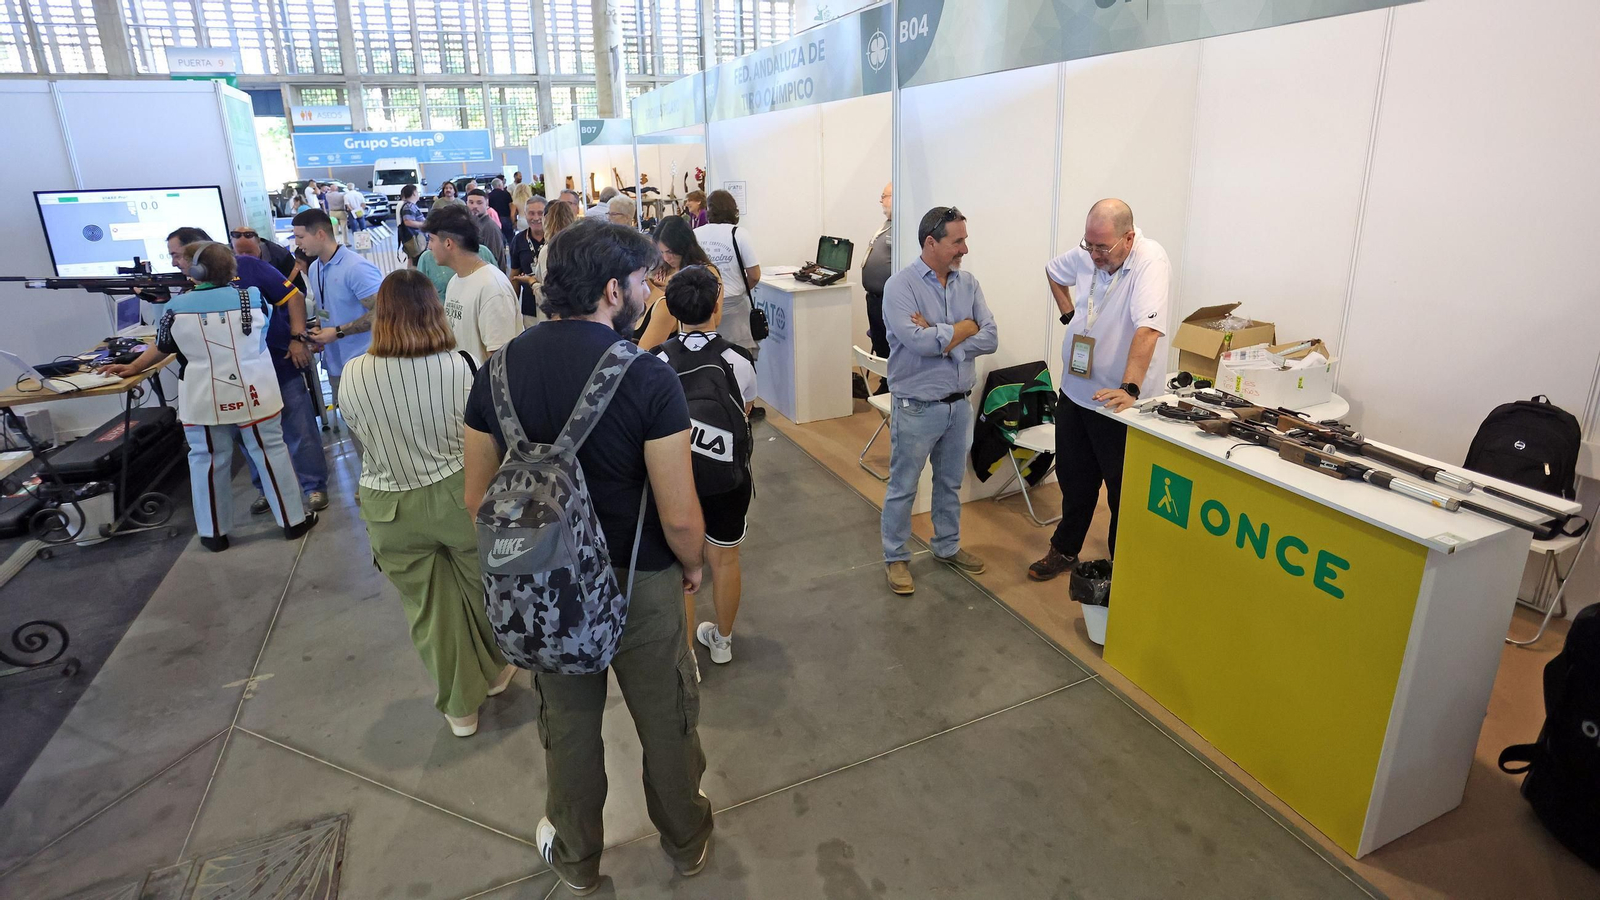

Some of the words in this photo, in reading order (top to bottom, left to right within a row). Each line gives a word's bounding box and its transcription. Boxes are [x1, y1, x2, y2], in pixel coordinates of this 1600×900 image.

[899, 13, 930, 44] B04
[177, 58, 213, 67] PUERTA
[218, 59, 225, 68] 9
[734, 67, 751, 86] FED.
[753, 45, 805, 80] ANDALUZA
[807, 38, 826, 64] DE
[740, 89, 762, 111] TIRO
[763, 77, 814, 107] OLÍMPICO
[316, 111, 343, 120] ASEOS
[581, 126, 597, 134] B07
[343, 137, 389, 151] Grupo
[390, 136, 434, 148] Solera
[140, 200, 159, 211] 0.0
[219, 401, 245, 412] ESP
[691, 426, 726, 456] ILA
[492, 537, 524, 556] NIKE
[1200, 499, 1351, 600] ONCE
